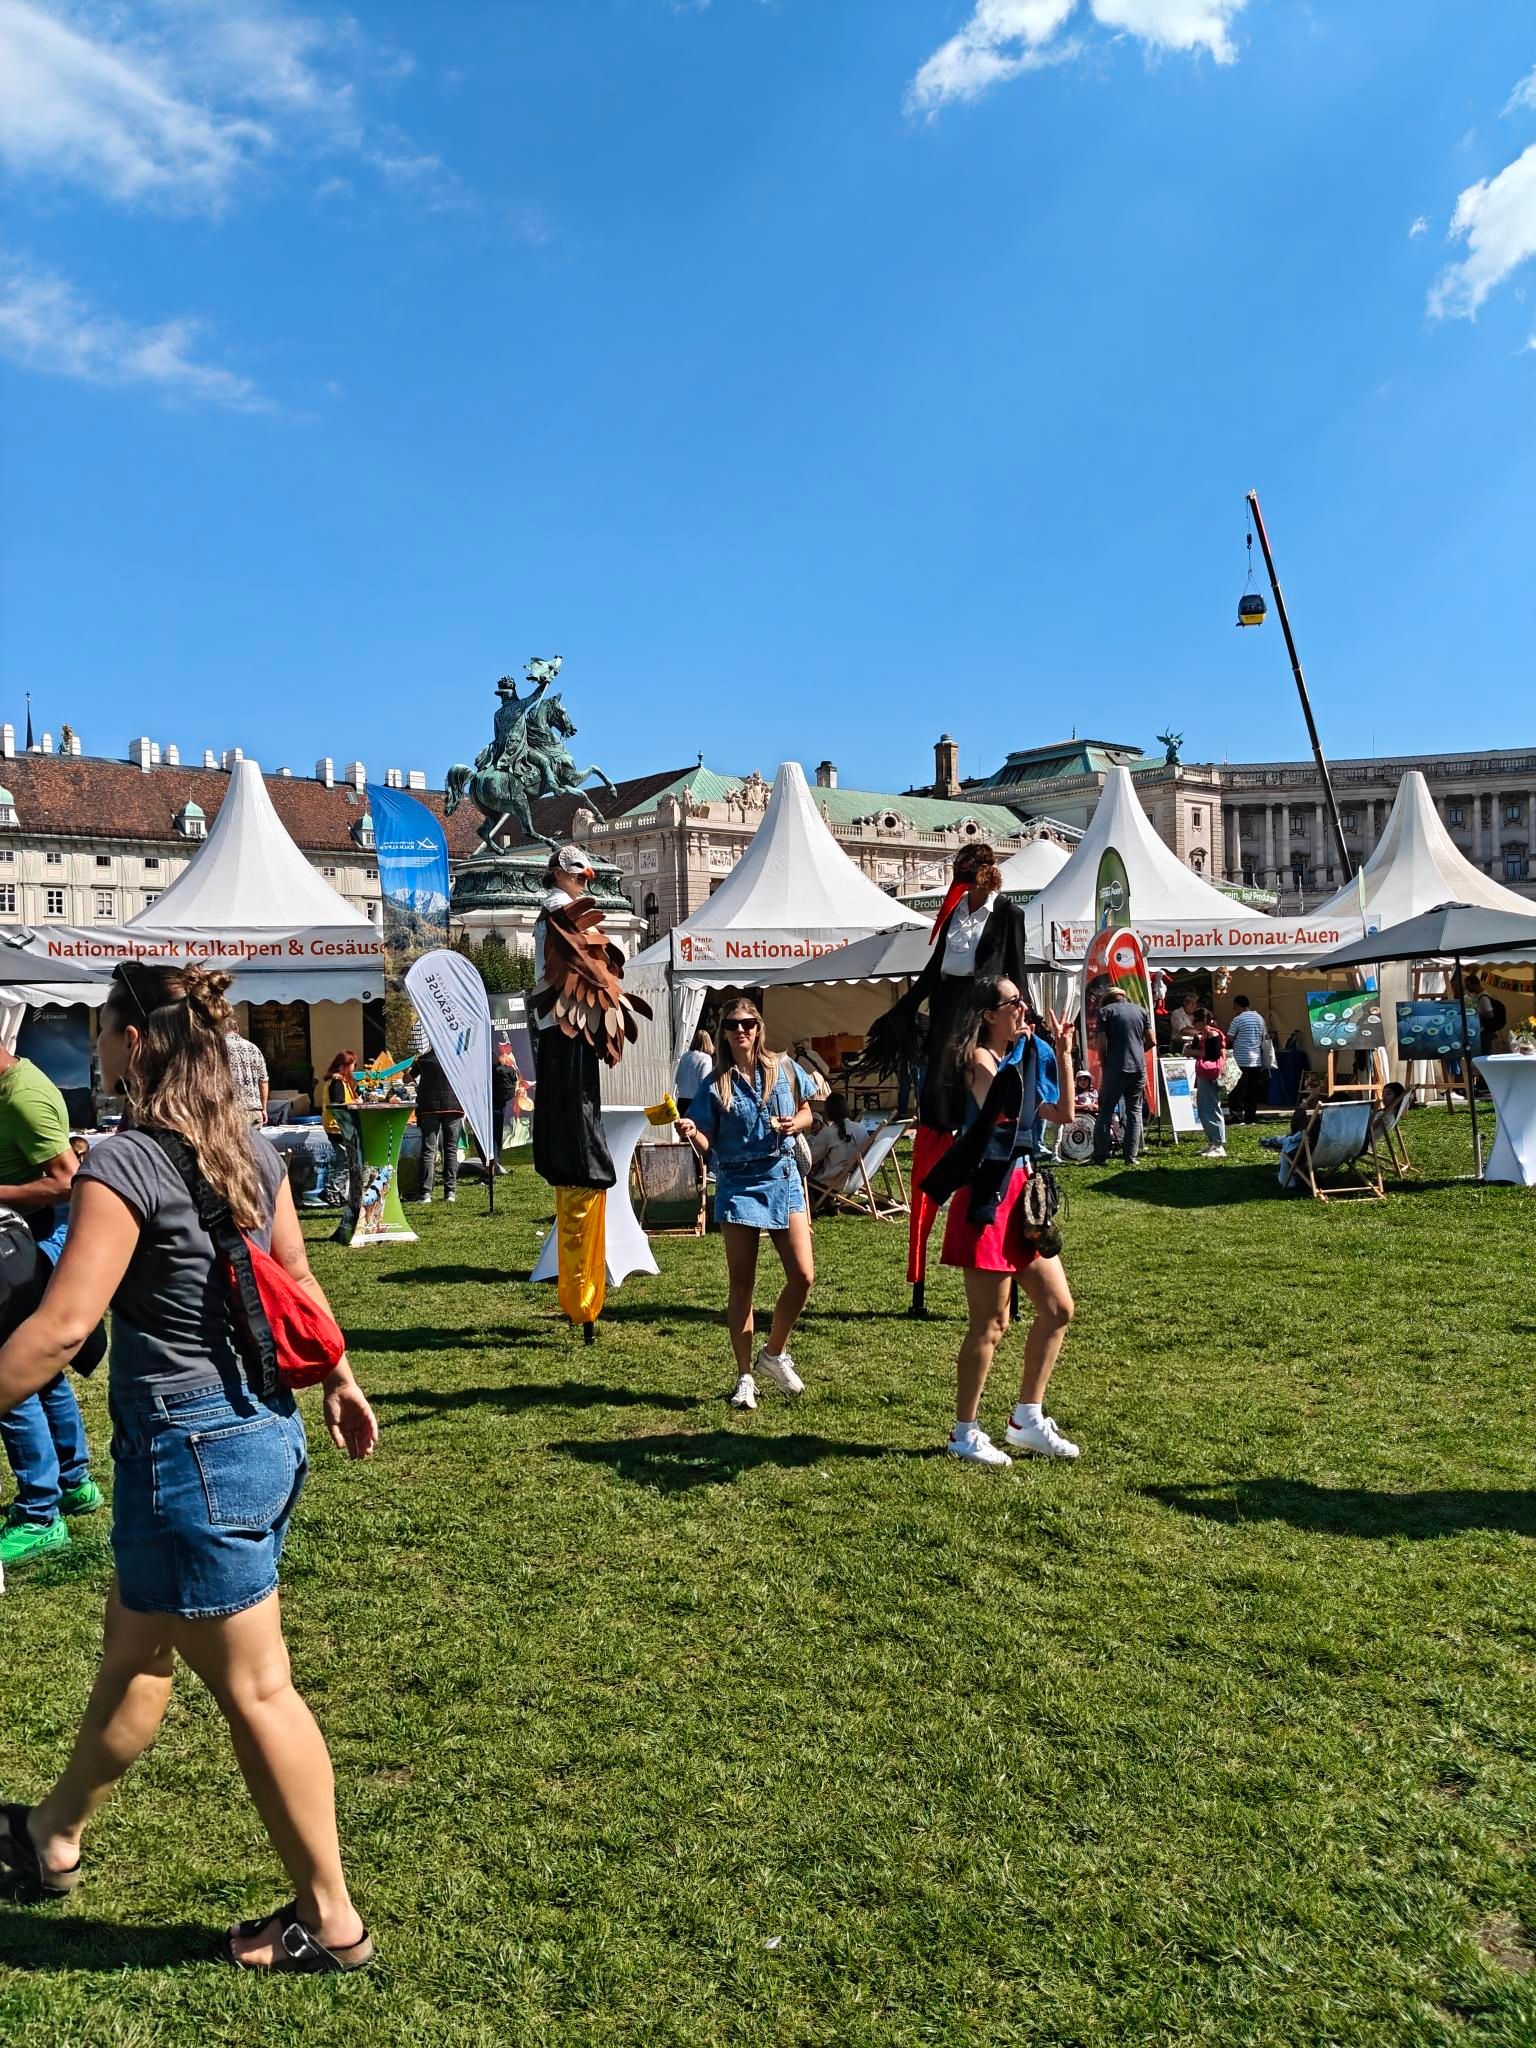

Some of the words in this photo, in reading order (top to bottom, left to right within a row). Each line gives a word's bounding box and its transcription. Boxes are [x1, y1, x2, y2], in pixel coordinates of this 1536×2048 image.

[48, 939, 180, 961] Nationalpark
[185, 939, 282, 961] Kalkalpen
[288, 939, 304, 956] &
[726, 938, 849, 959] Nationalpar
[1136, 928, 1224, 952] onalpark
[1228, 927, 1339, 946] Donau-Auen
[229, 1244, 262, 1317] BAGGU
